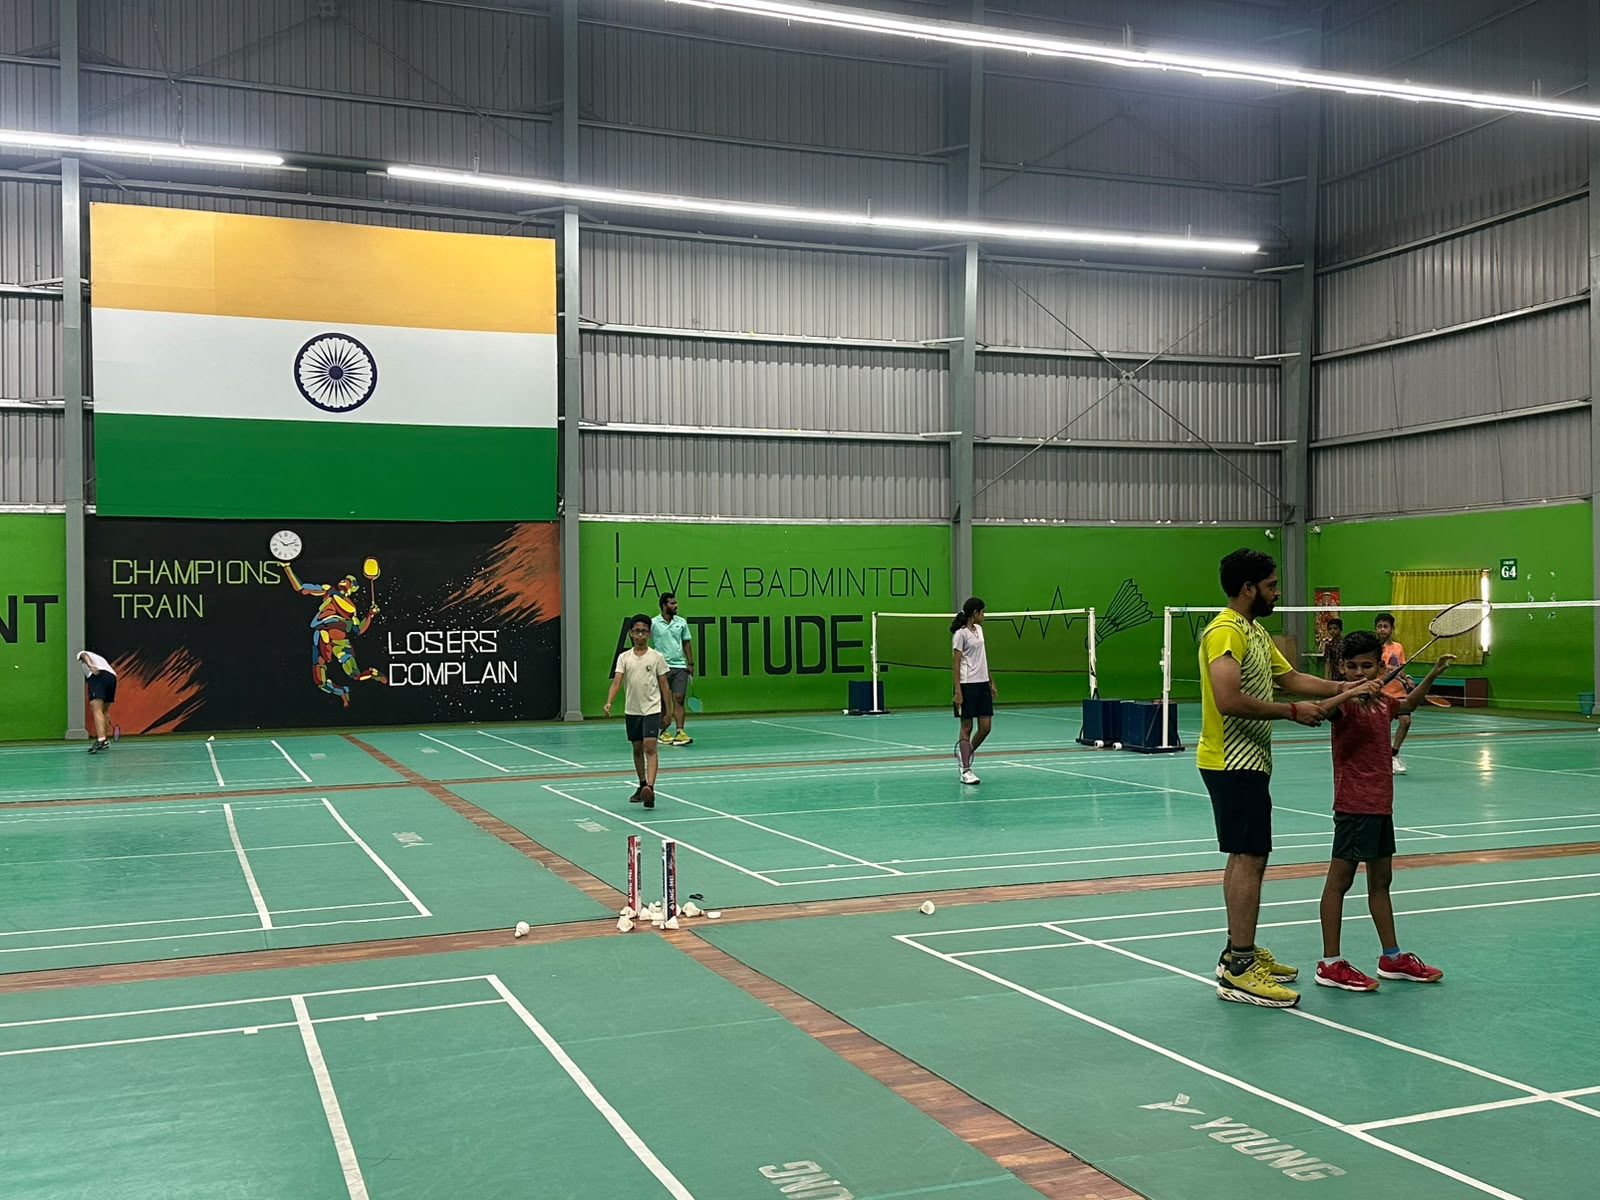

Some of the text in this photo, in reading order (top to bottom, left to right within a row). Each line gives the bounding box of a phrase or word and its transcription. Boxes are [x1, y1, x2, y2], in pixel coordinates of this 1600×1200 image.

[615, 532, 620, 563] I
[112, 559, 282, 585] CHAMPIONS
[615, 566, 931, 598] HAVE A BADMINTON
[1501, 565, 1516, 578] G4
[113, 594, 203, 619] TRAIN
[388, 630, 498, 655] LOSERS
[609, 614, 888, 679] ATITUDE.
[388, 660, 518, 687] COMPLAIN
[1189, 1116, 1347, 1181] YOUNG
